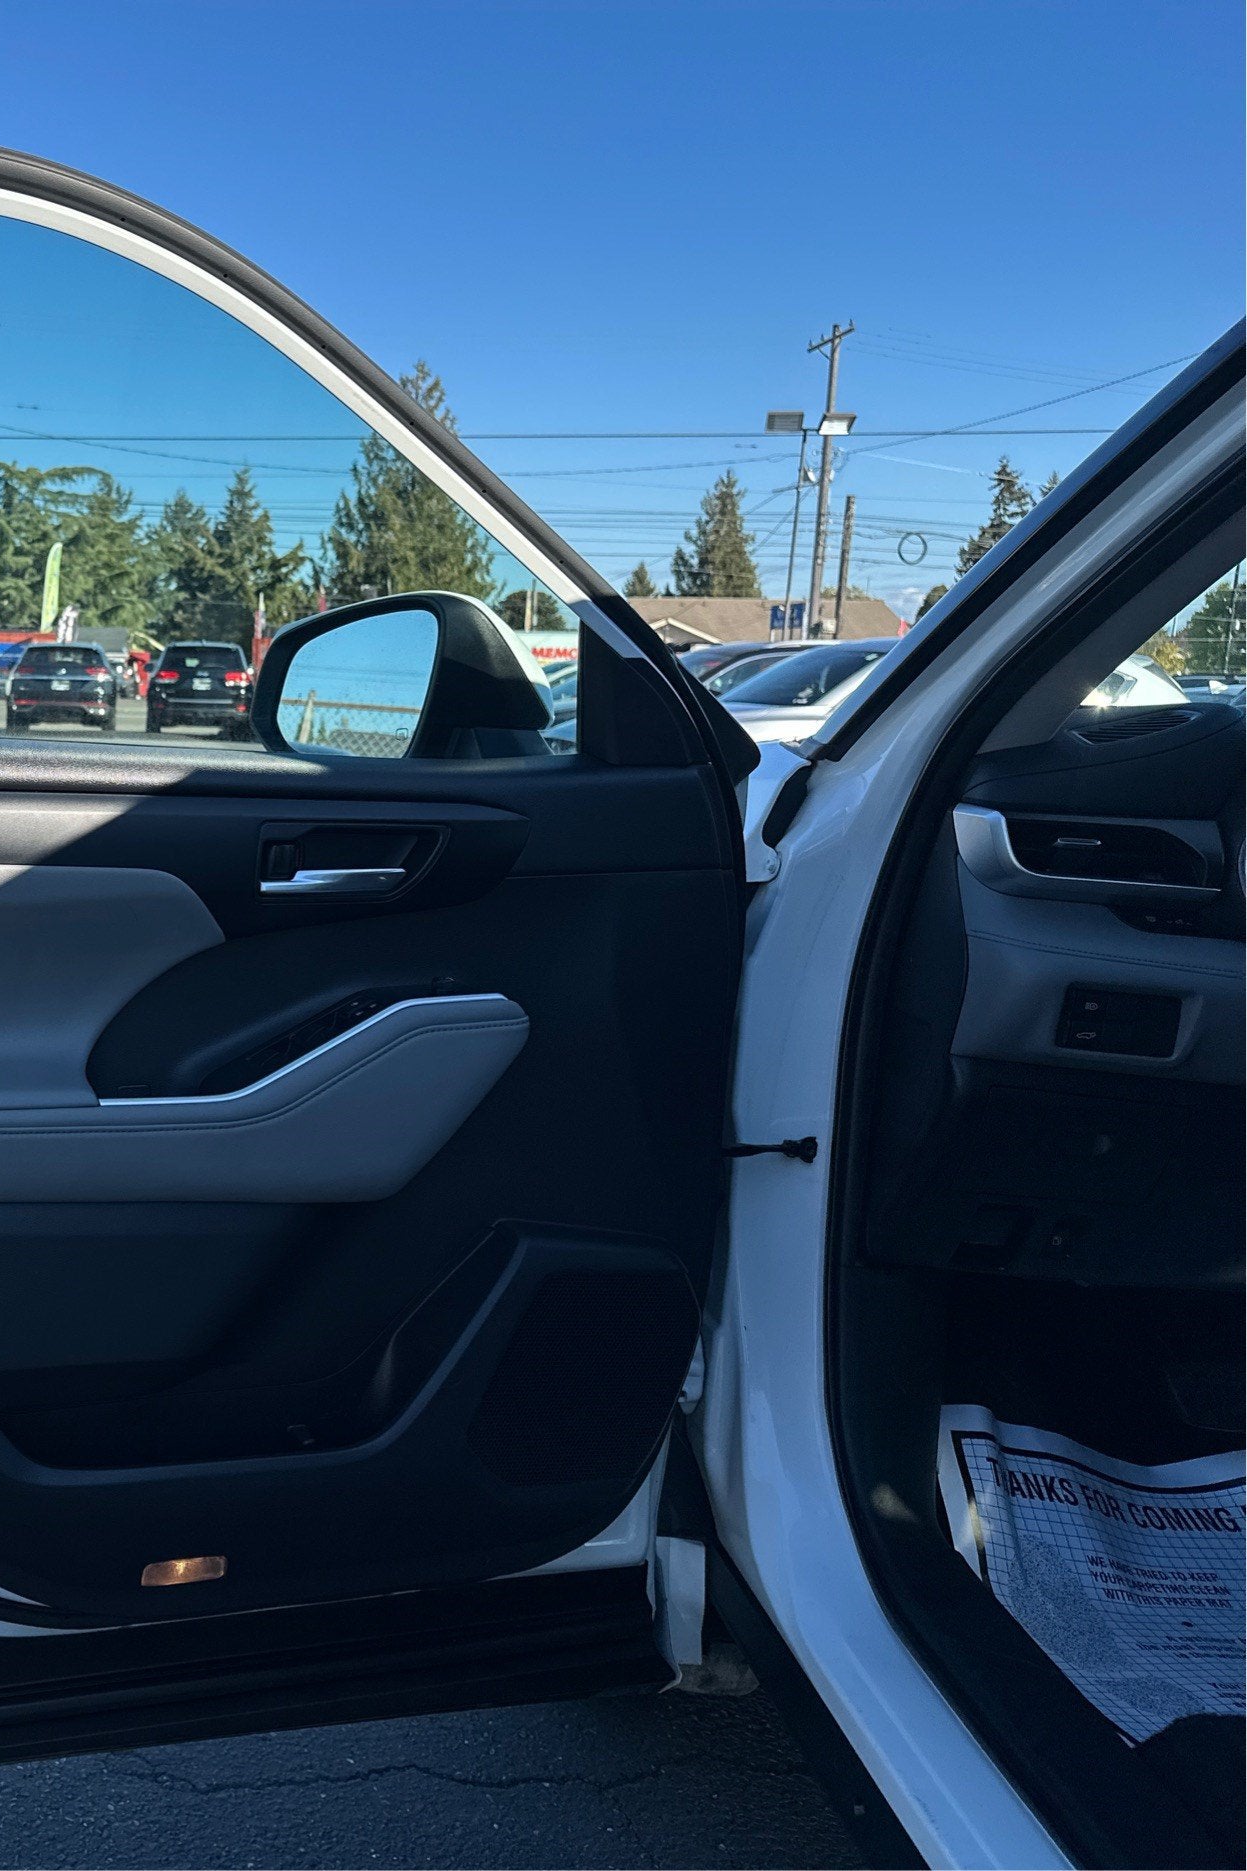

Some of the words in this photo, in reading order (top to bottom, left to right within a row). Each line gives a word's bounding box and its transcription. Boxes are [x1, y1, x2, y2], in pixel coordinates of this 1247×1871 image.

[986, 1456, 1080, 1507] TANKS
[1079, 1482, 1128, 1525] FOR
[1127, 1502, 1242, 1533] COMING
[1087, 1555, 1107, 1568] WE
[1133, 1567, 1169, 1581] TRIED
[1170, 1571, 1188, 1582] TO
[1188, 1572, 1219, 1583] KEEP
[1090, 1570, 1127, 1586] YOUR
[1189, 1585, 1232, 1596] CLEAN
[1102, 1588, 1135, 1601] WITH
[1136, 1594, 1164, 1606] THIS
